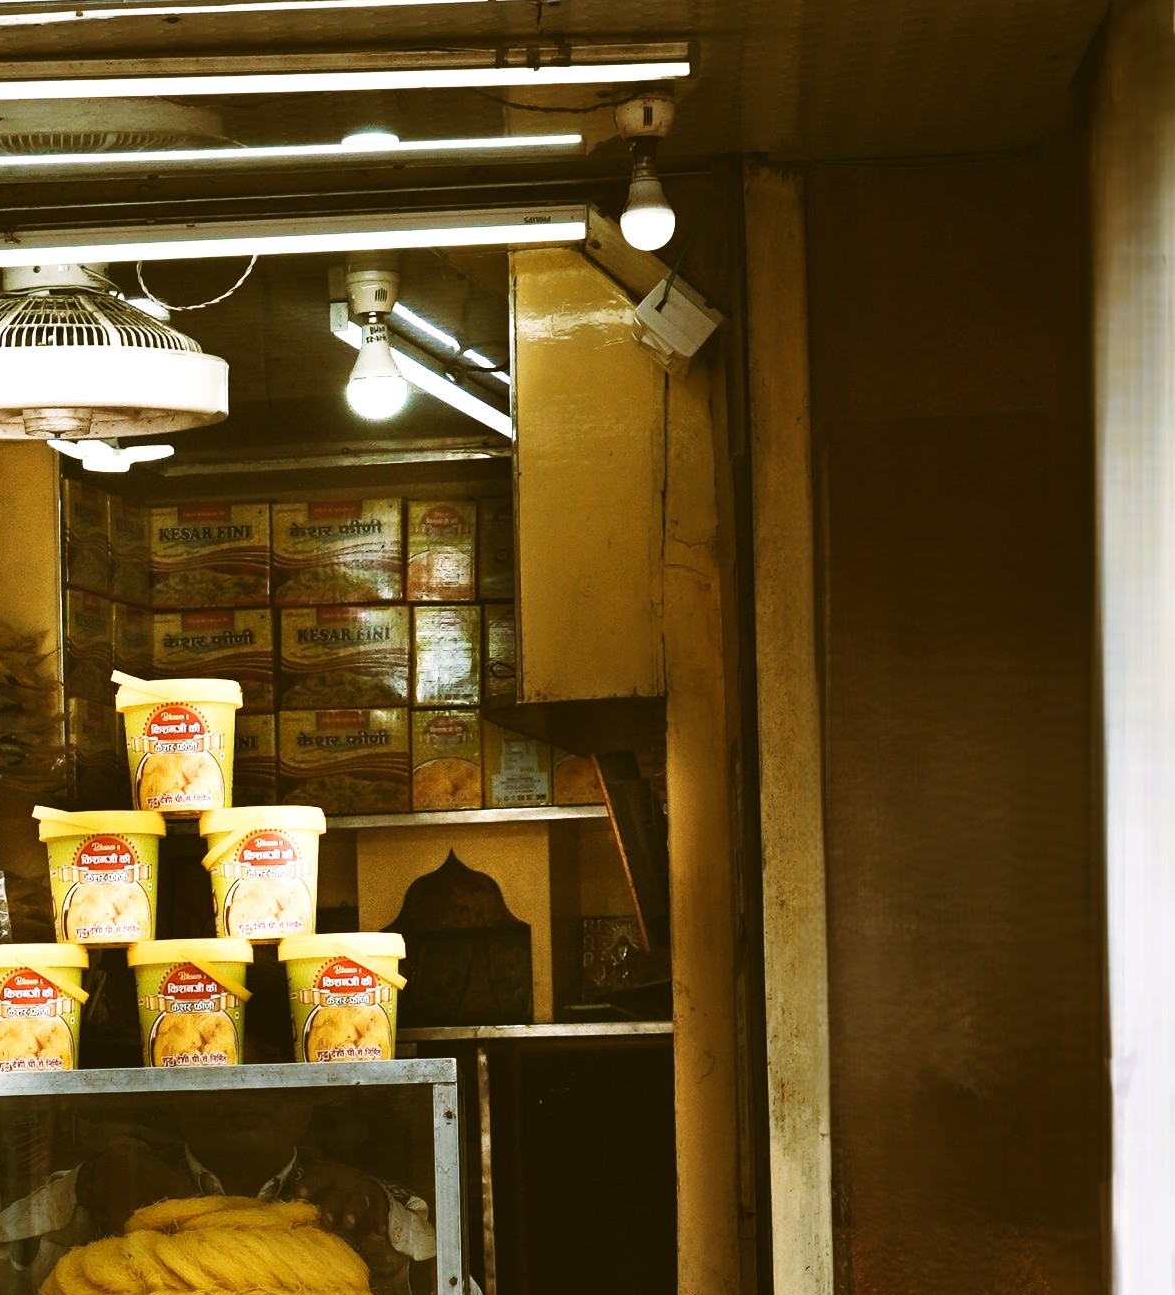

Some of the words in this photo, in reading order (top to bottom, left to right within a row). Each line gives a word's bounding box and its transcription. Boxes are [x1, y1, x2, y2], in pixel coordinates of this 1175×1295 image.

[159, 527, 212, 541] KESAR
[217, 525, 253, 540] FINI
[297, 628, 351, 642] KESAR
